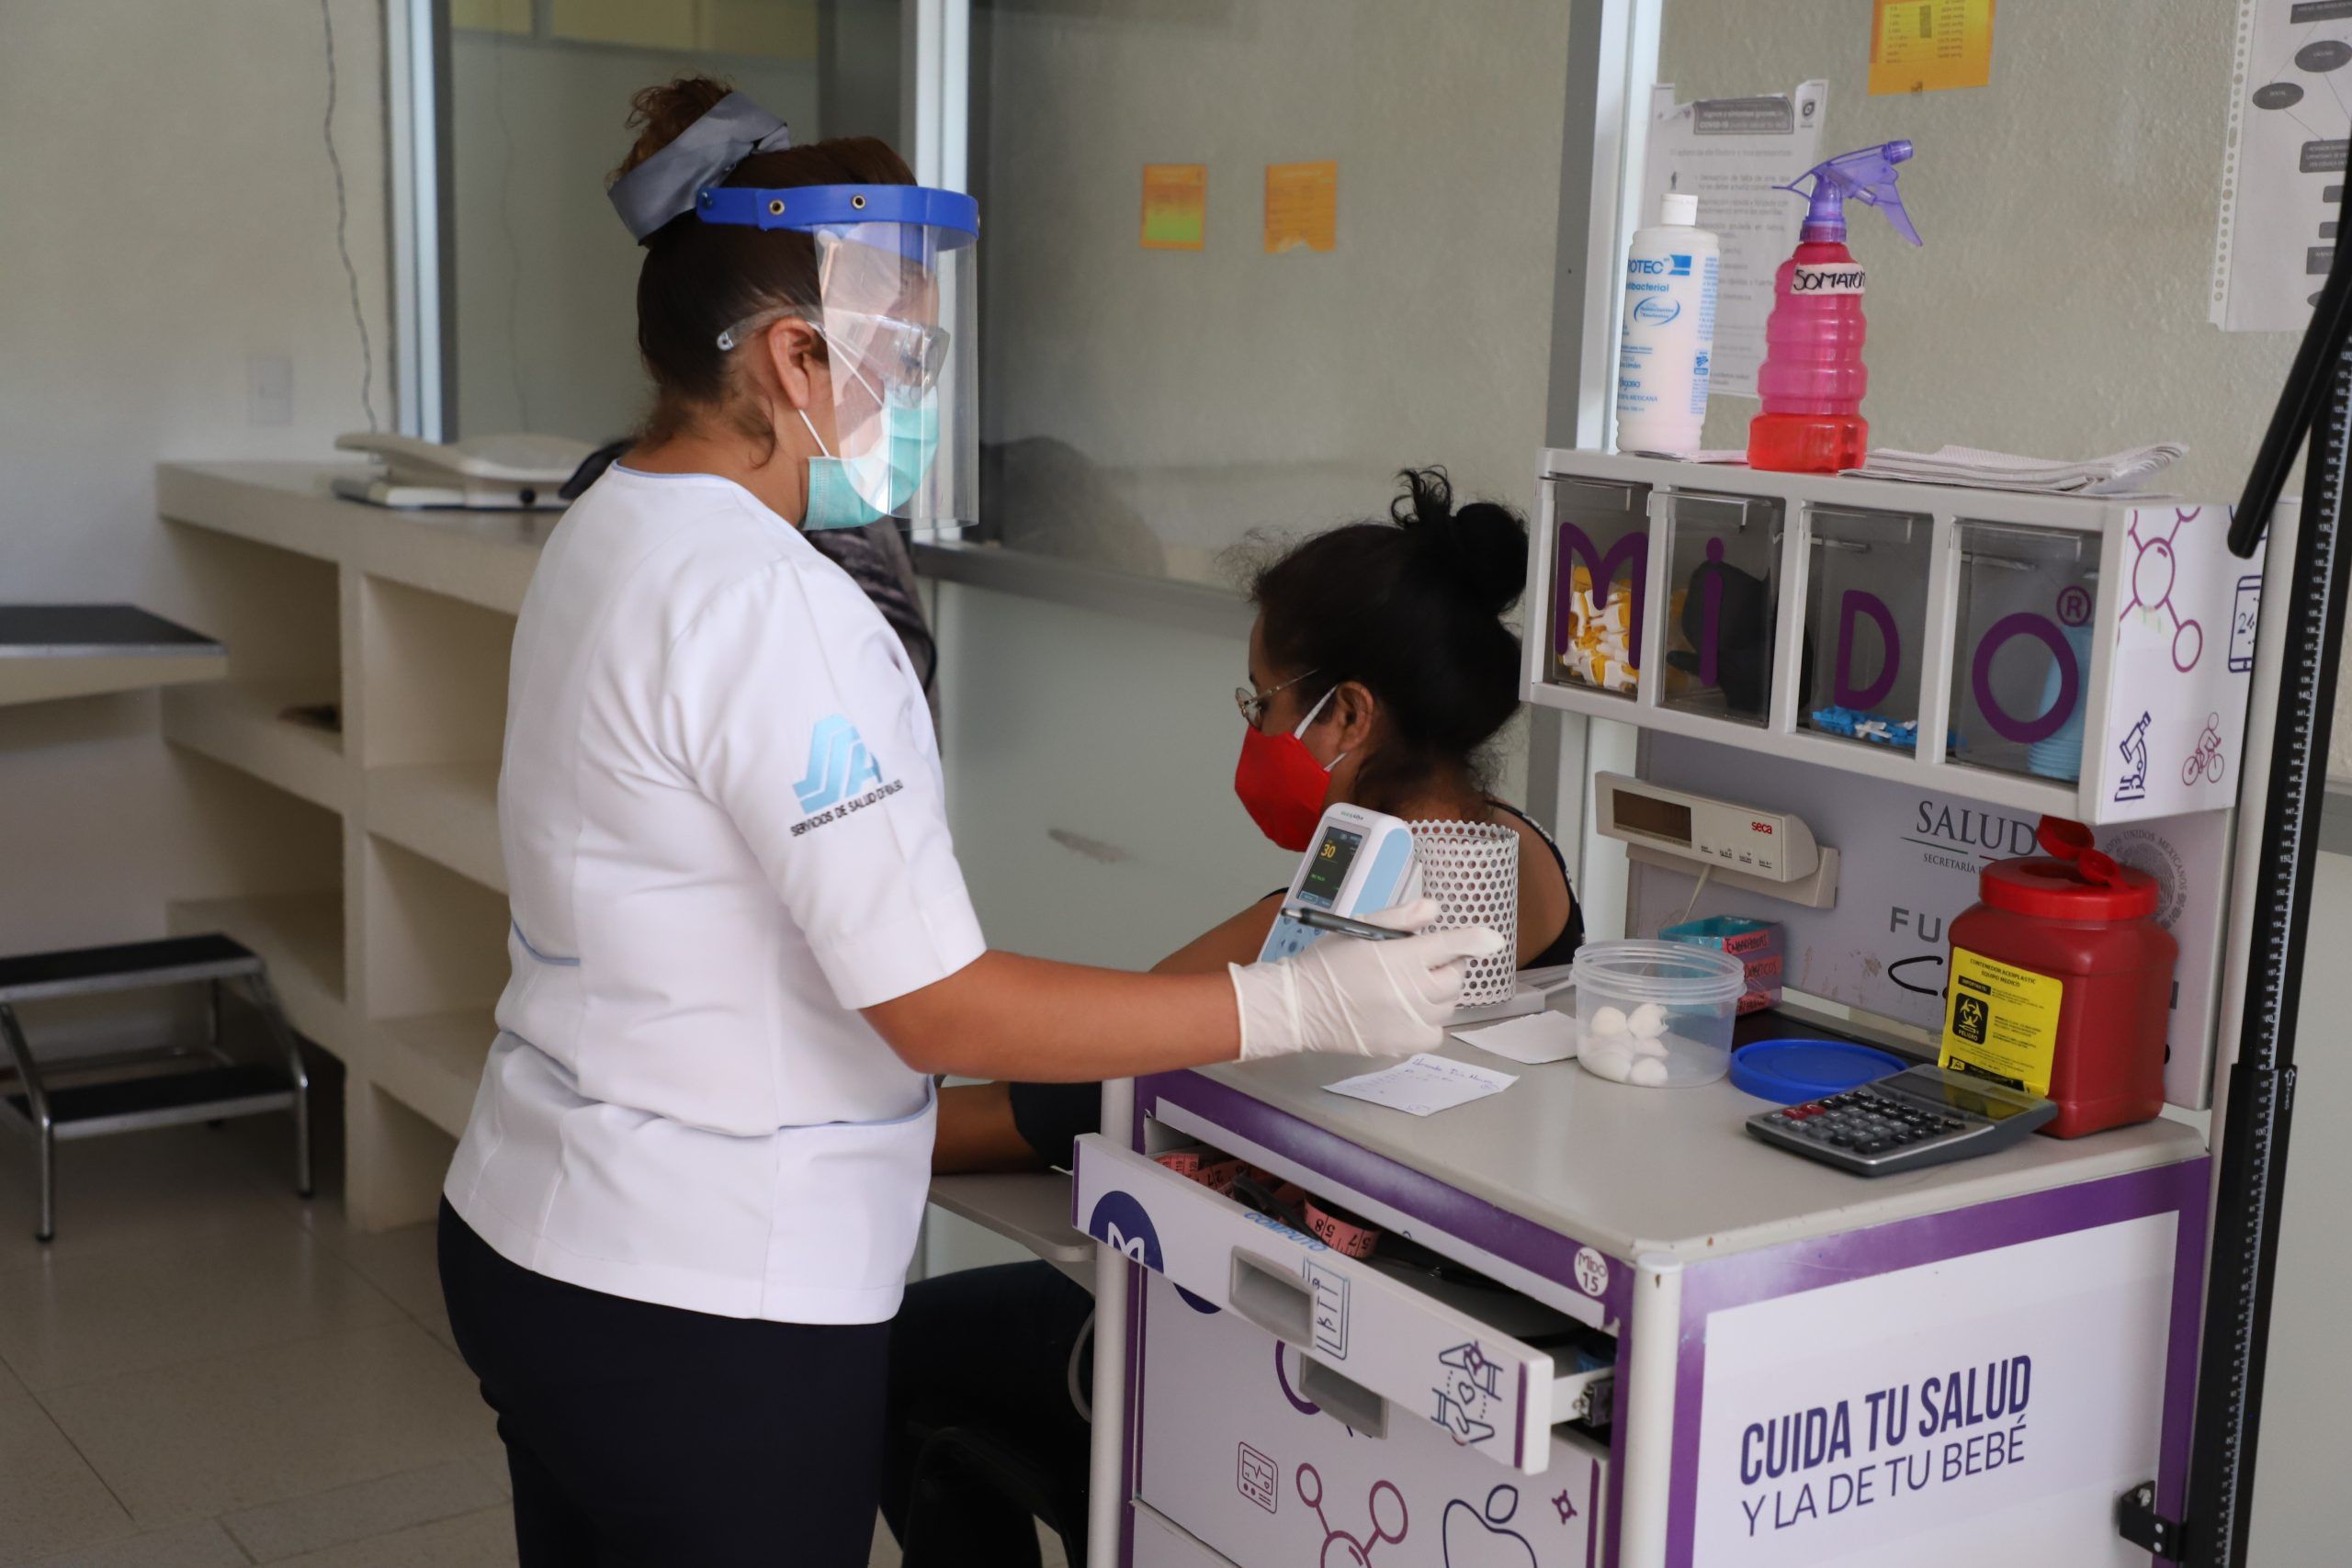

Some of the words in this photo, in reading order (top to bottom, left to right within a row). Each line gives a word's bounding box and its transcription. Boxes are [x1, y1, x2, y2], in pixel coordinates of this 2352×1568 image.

[834, 804, 848, 819] DE
[848, 790, 877, 814] SALUD
[1751, 821, 1772, 835] seca
[1916, 800, 2038, 856] SALUD
[1320, 843, 1337, 859] 30
[1923, 852, 1976, 874] SECRETARÍA
[1958, 1029, 1978, 1042] PELIGRO
[1583, 1272, 1599, 1292] 15
[1740, 1399, 1851, 1486] CUIDA
[1865, 1384, 1910, 1452] TU
[1918, 1354, 2031, 1438] SALUD
[1741, 1495, 1766, 1538] Y
[1774, 1483, 1817, 1530] LA
[1827, 1464, 1877, 1515] DE
[1884, 1450, 1931, 1497] TU
[1942, 1414, 2028, 1483] BEBÉ
